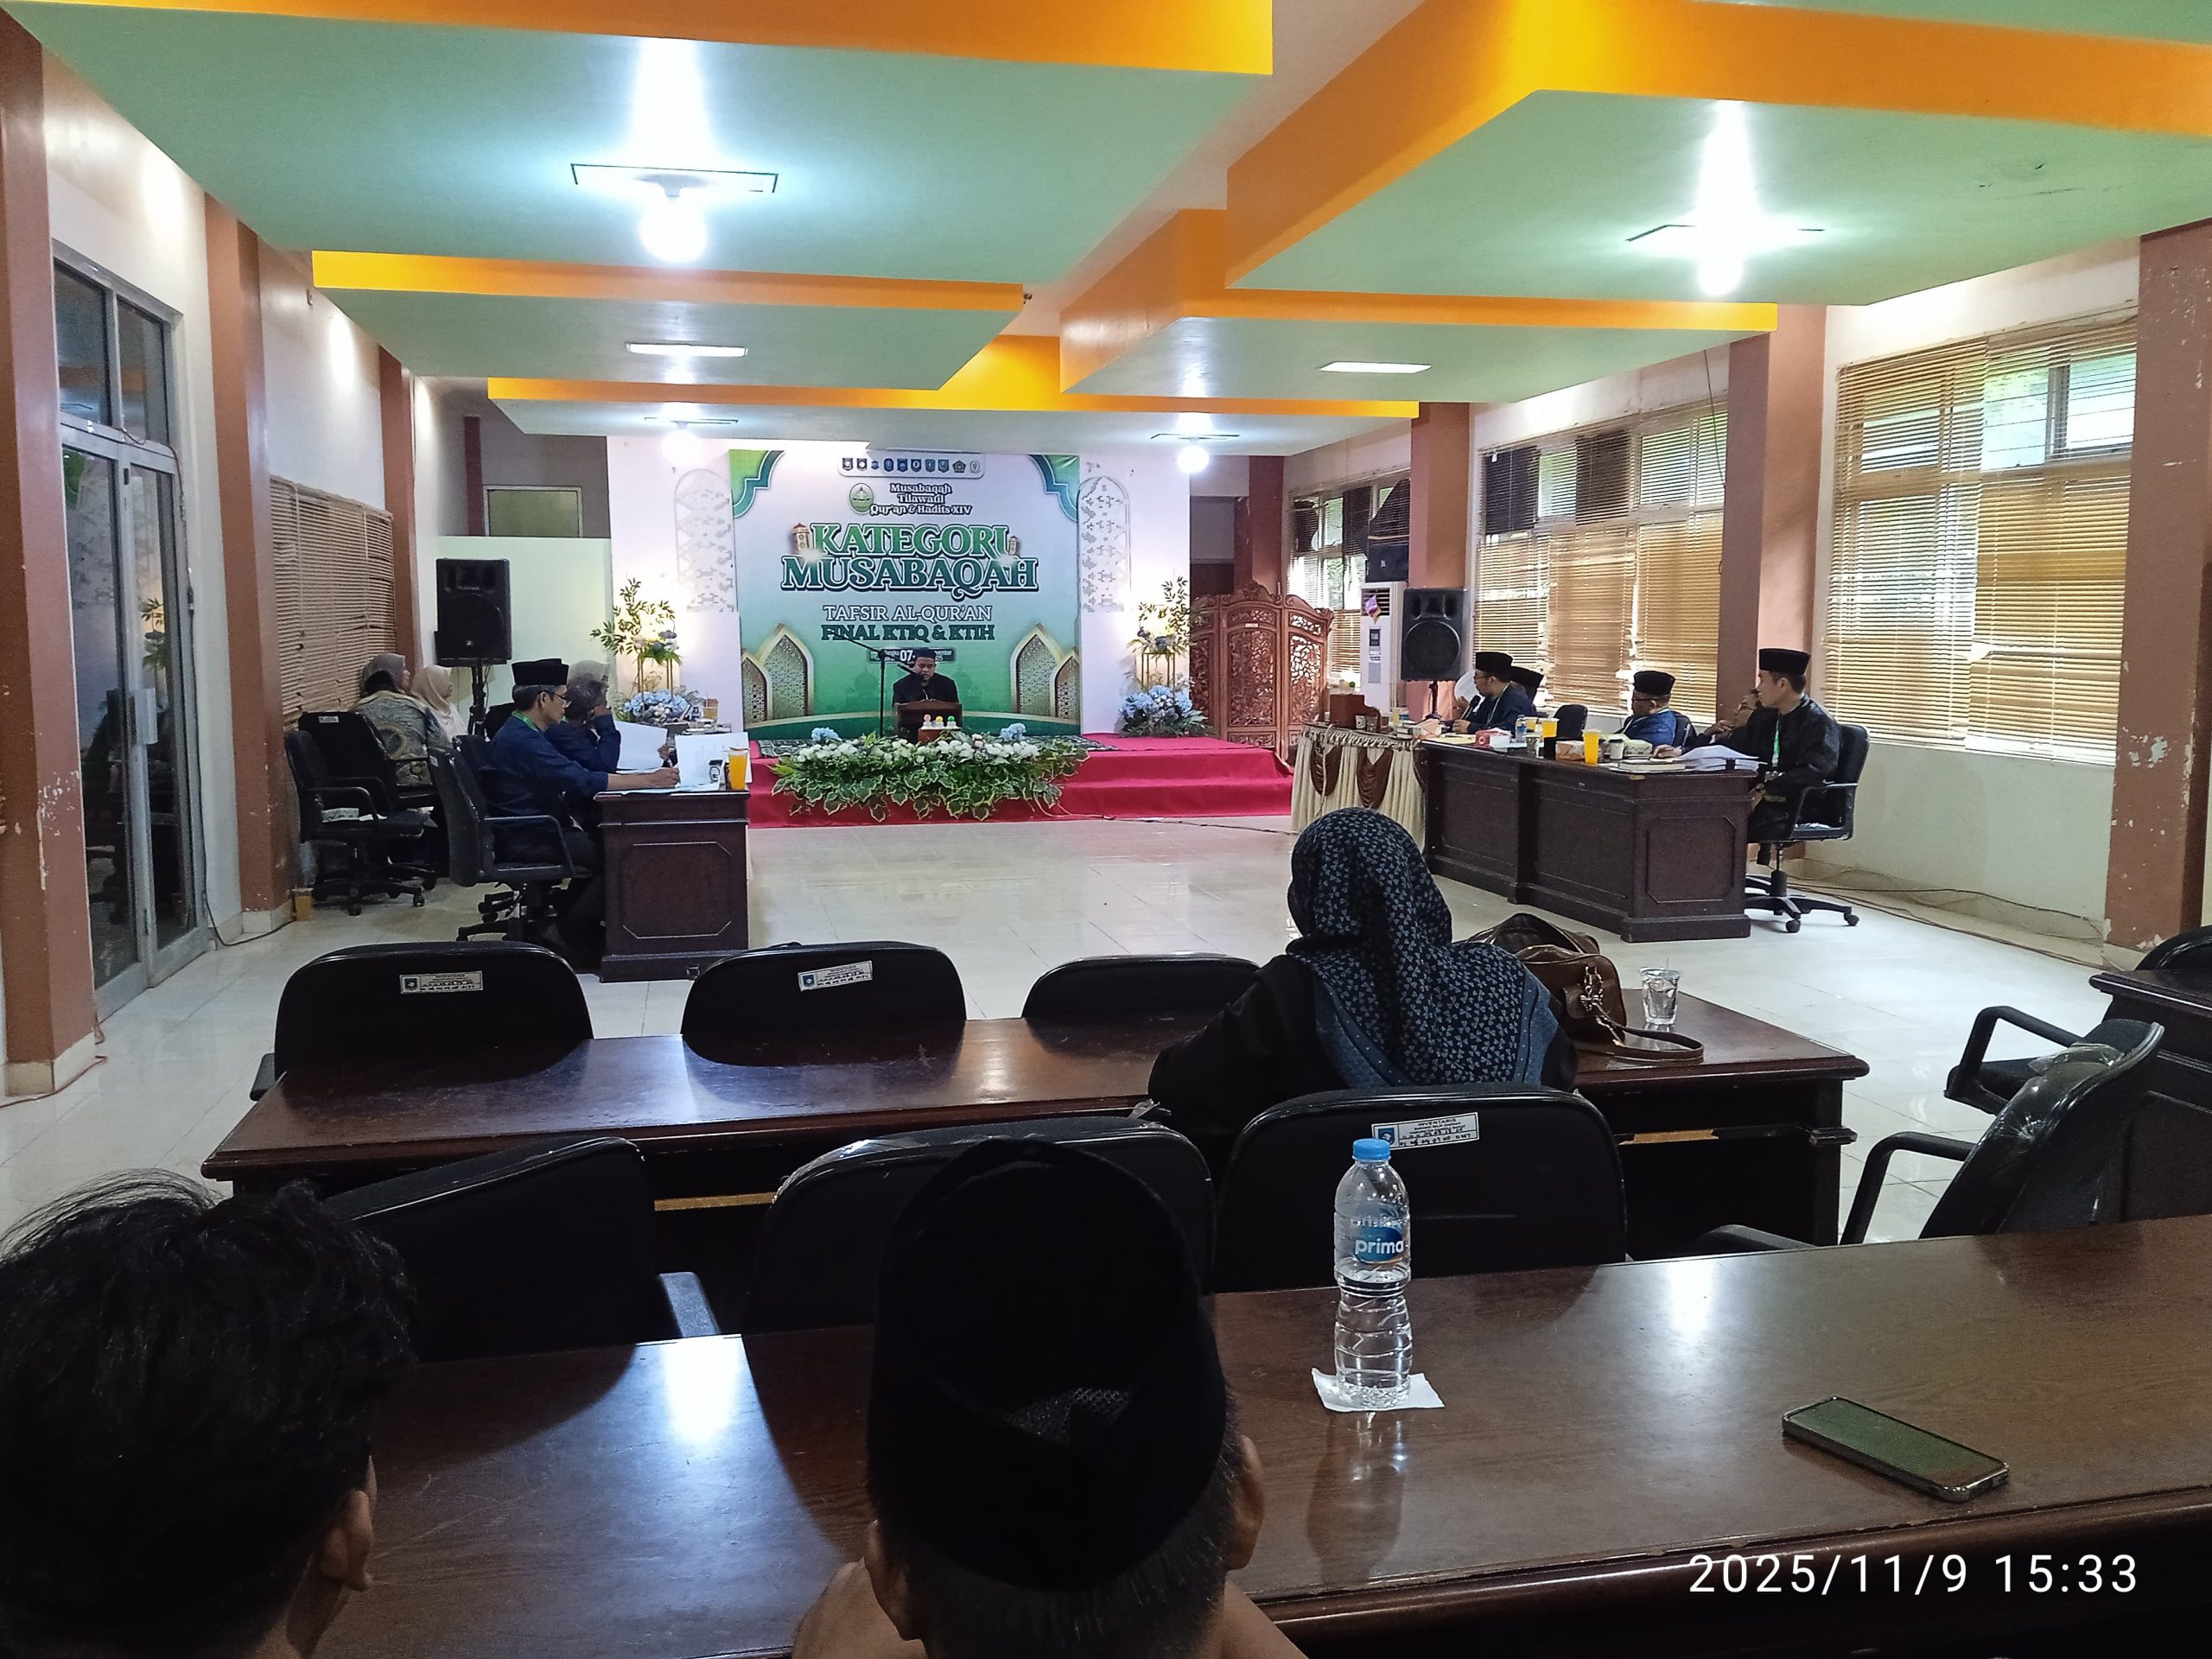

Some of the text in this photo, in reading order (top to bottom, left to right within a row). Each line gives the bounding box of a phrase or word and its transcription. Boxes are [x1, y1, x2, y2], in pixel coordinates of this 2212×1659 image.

[890, 483, 952, 495] Musabaqah
[898, 493, 944, 504] Tilawatil
[870, 504, 972, 515] Qur'an & Hadits XIV
[810, 524, 1009, 557] KATEGORI
[781, 556, 1039, 602] MUSABAQAH
[823, 606, 993, 623] TAFSIR AL-QUR'AN
[822, 624, 995, 643] FINAL KTIQ & KTIH
[1355, 1237, 1404, 1255] prima
